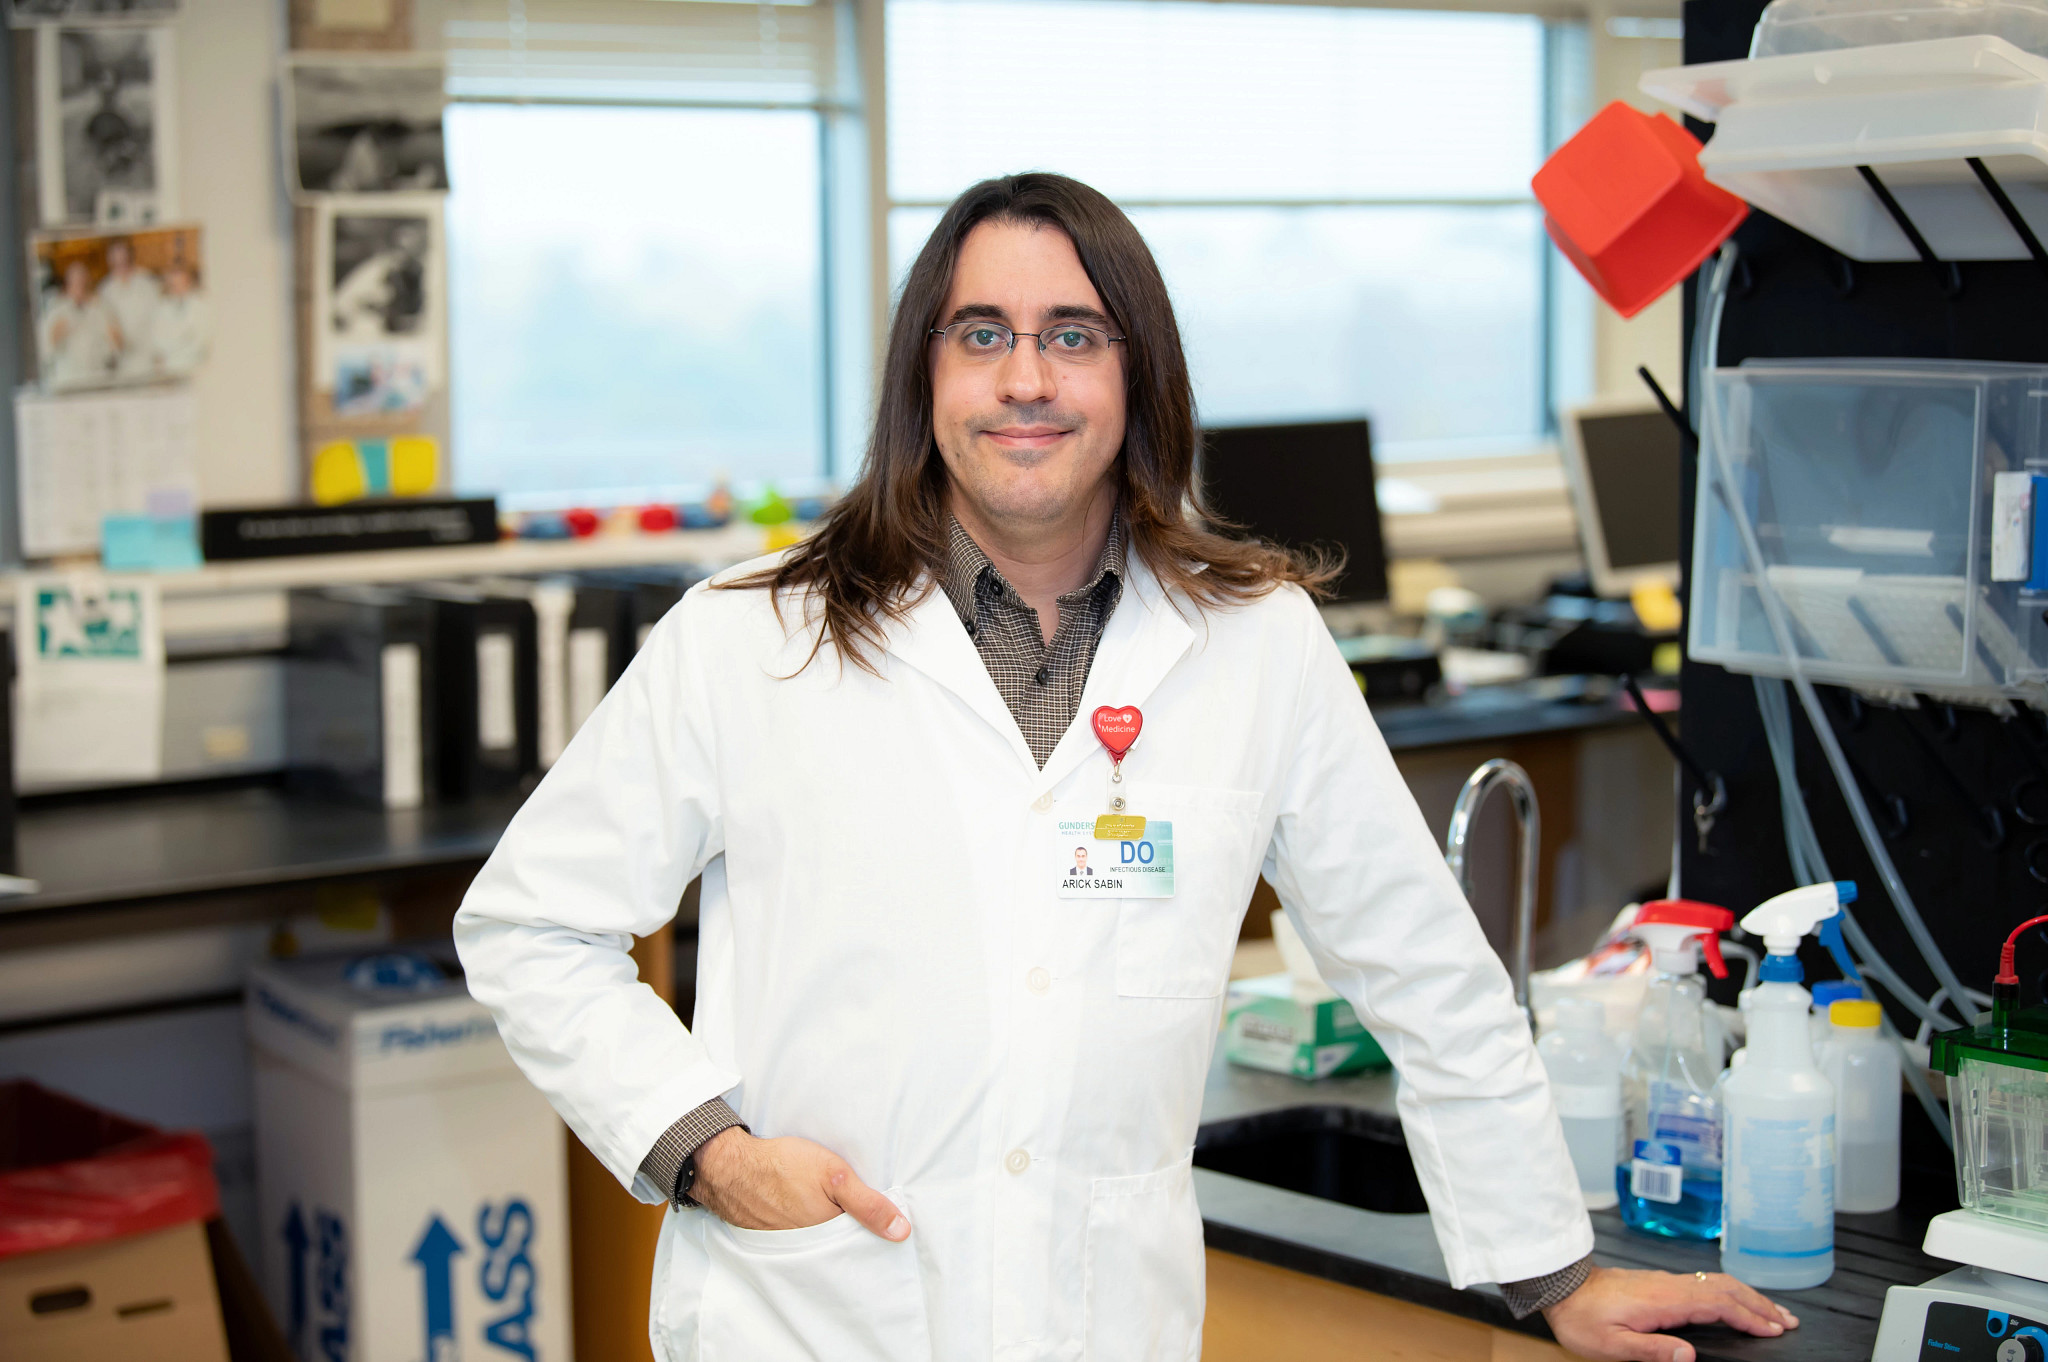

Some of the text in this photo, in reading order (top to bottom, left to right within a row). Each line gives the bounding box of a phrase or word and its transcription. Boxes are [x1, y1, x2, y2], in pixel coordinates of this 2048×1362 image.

[1103, 714, 1121, 722] Love
[1120, 841, 1154, 864] DO
[1062, 879, 1123, 889] ARICK SABIN
